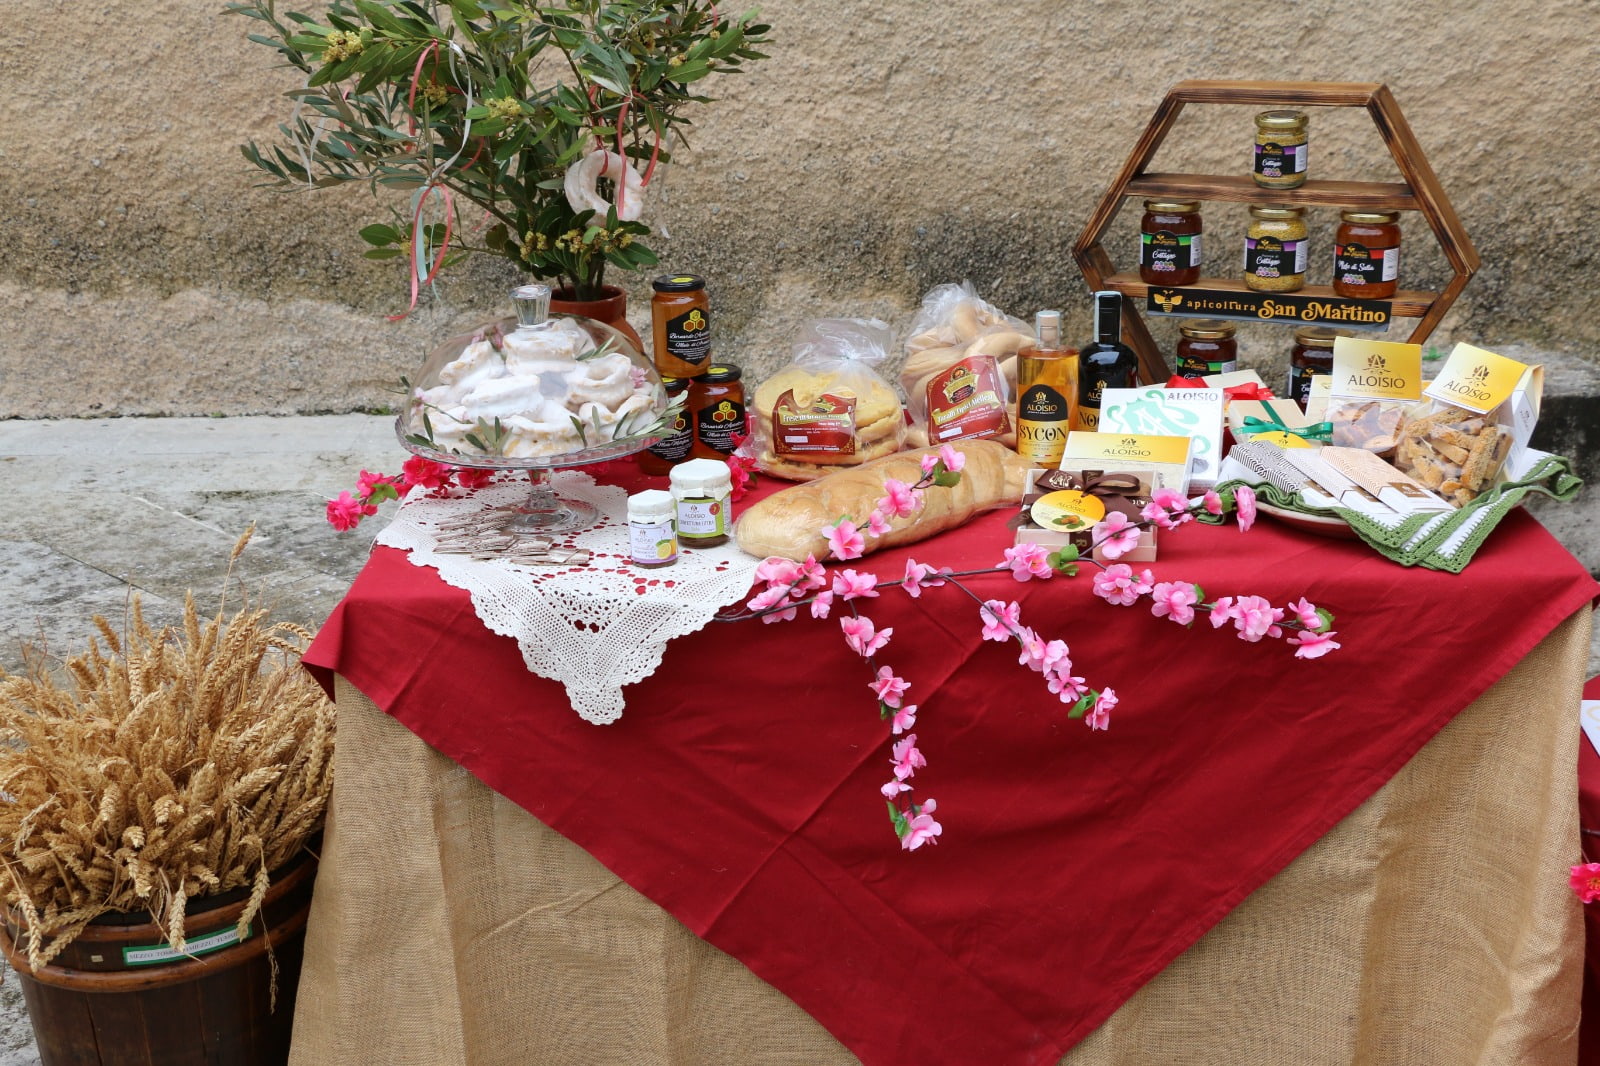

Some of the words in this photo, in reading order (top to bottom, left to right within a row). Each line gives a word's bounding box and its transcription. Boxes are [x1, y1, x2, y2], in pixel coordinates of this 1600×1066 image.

[1187, 299, 1257, 312] apicoltura
[1257, 299, 1297, 319] San
[1301, 301, 1386, 323] Martino
[1347, 374, 1406, 389] ALOISIO
[1167, 392, 1219, 402] ALOISIO
[1442, 380, 1492, 401] ALOISIO
[1026, 404, 1058, 412] ALOISIO
[1019, 424, 1067, 442] SYCON
[1102, 448, 1151, 457] ALOISIO
[1056, 501, 1086, 514] ALOISIO
